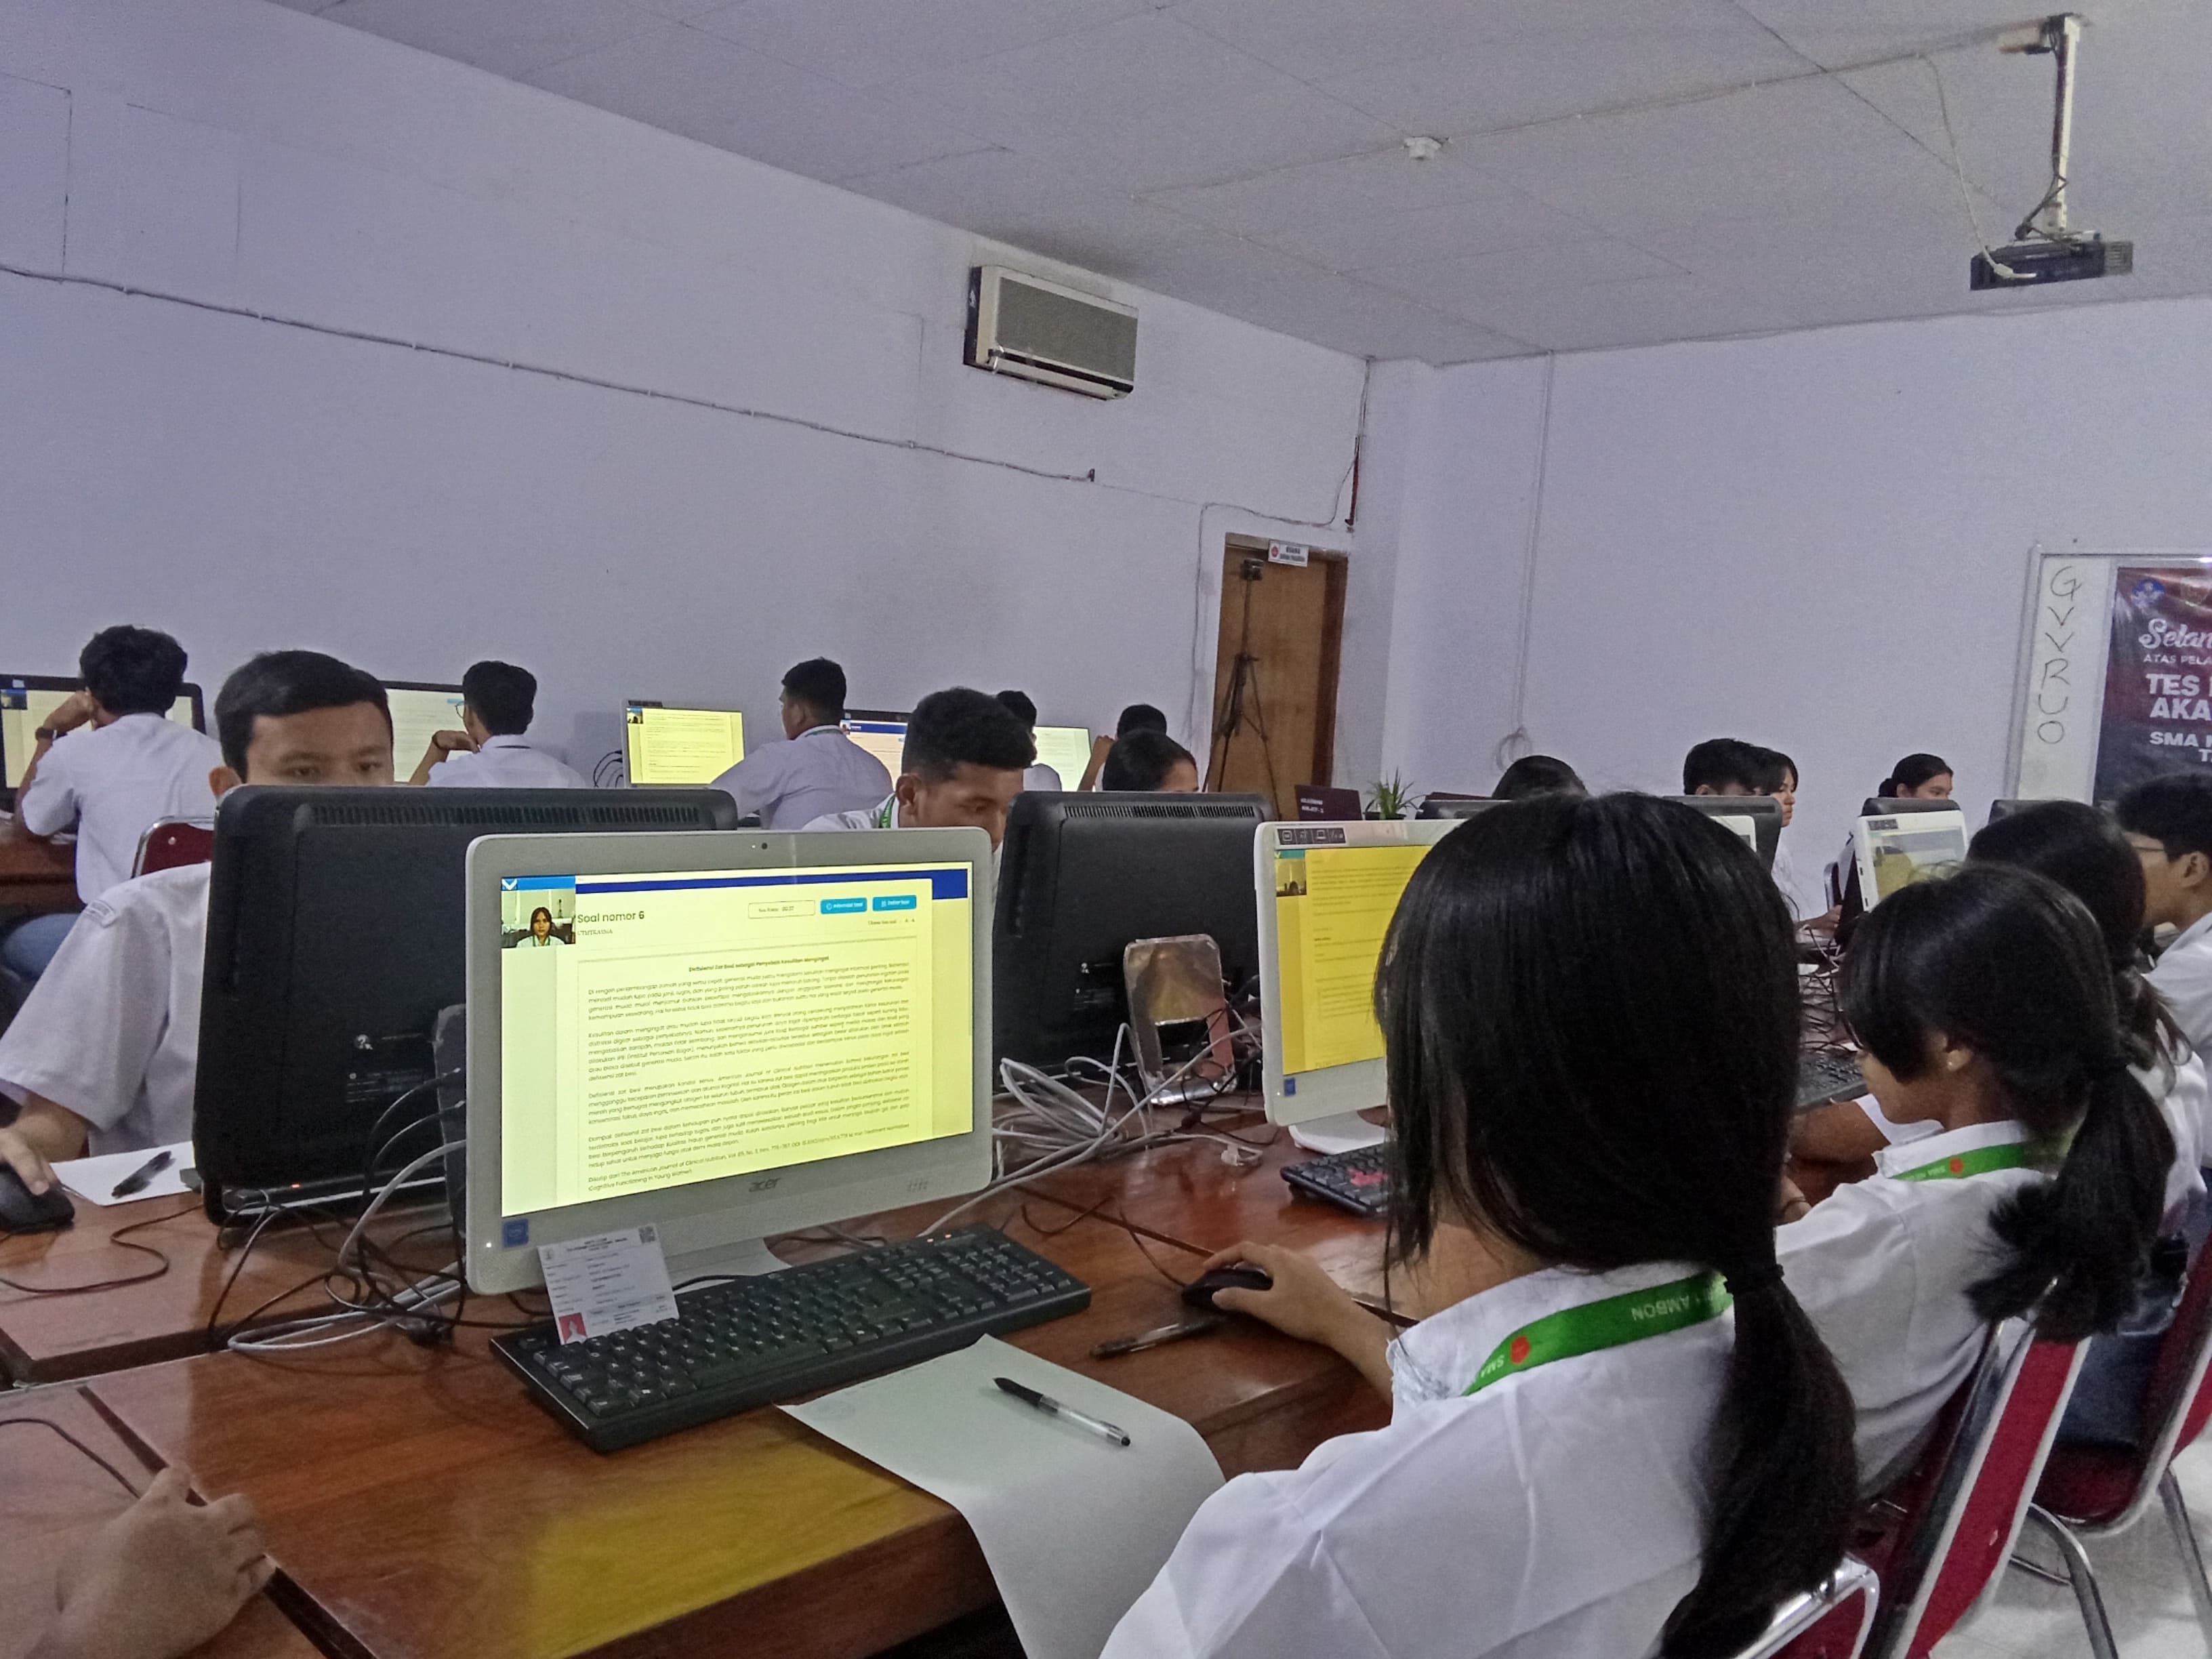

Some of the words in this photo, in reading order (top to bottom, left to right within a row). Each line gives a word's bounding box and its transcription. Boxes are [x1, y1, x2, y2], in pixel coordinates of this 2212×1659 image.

[2143, 654, 2177, 663] ATAS
[2146, 674, 2200, 697] TES
[2150, 731, 2198, 747] SMA
[577, 913, 600, 923] Soal
[602, 913, 636, 922] nomor
[638, 911, 644, 920] 6
[748, 1177, 781, 1193] acer
[1631, 1295, 1690, 1322] AMBON
